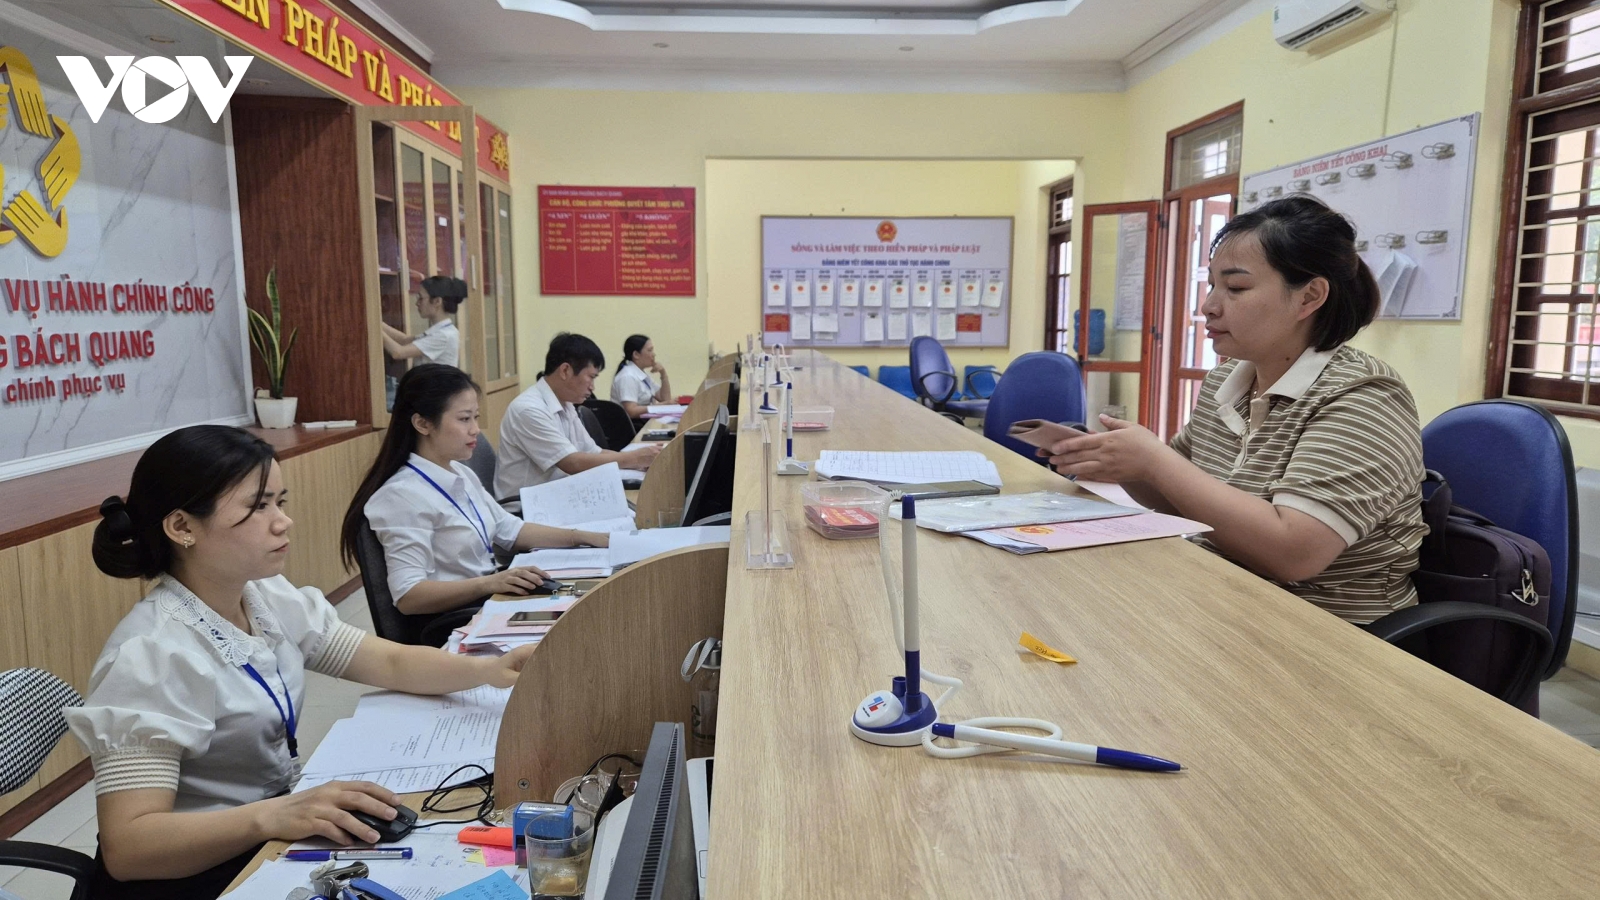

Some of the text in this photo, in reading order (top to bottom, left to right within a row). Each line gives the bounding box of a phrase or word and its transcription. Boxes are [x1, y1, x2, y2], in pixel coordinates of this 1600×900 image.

[283, 0, 357, 78] PHÁP
[362, 49, 394, 103] VÀ
[791, 241, 981, 254] SỐNG VÀ LÀM VIỆC THEO HIẾN PHÁP VÀ PHÁP LUẬT
[5, 274, 215, 319] VỤ HÀNH CHÍNH CÔNG
[15, 327, 81, 368] BÁCH
[89, 330, 155, 367] QUANG
[6, 373, 125, 403] chính phục vụ
